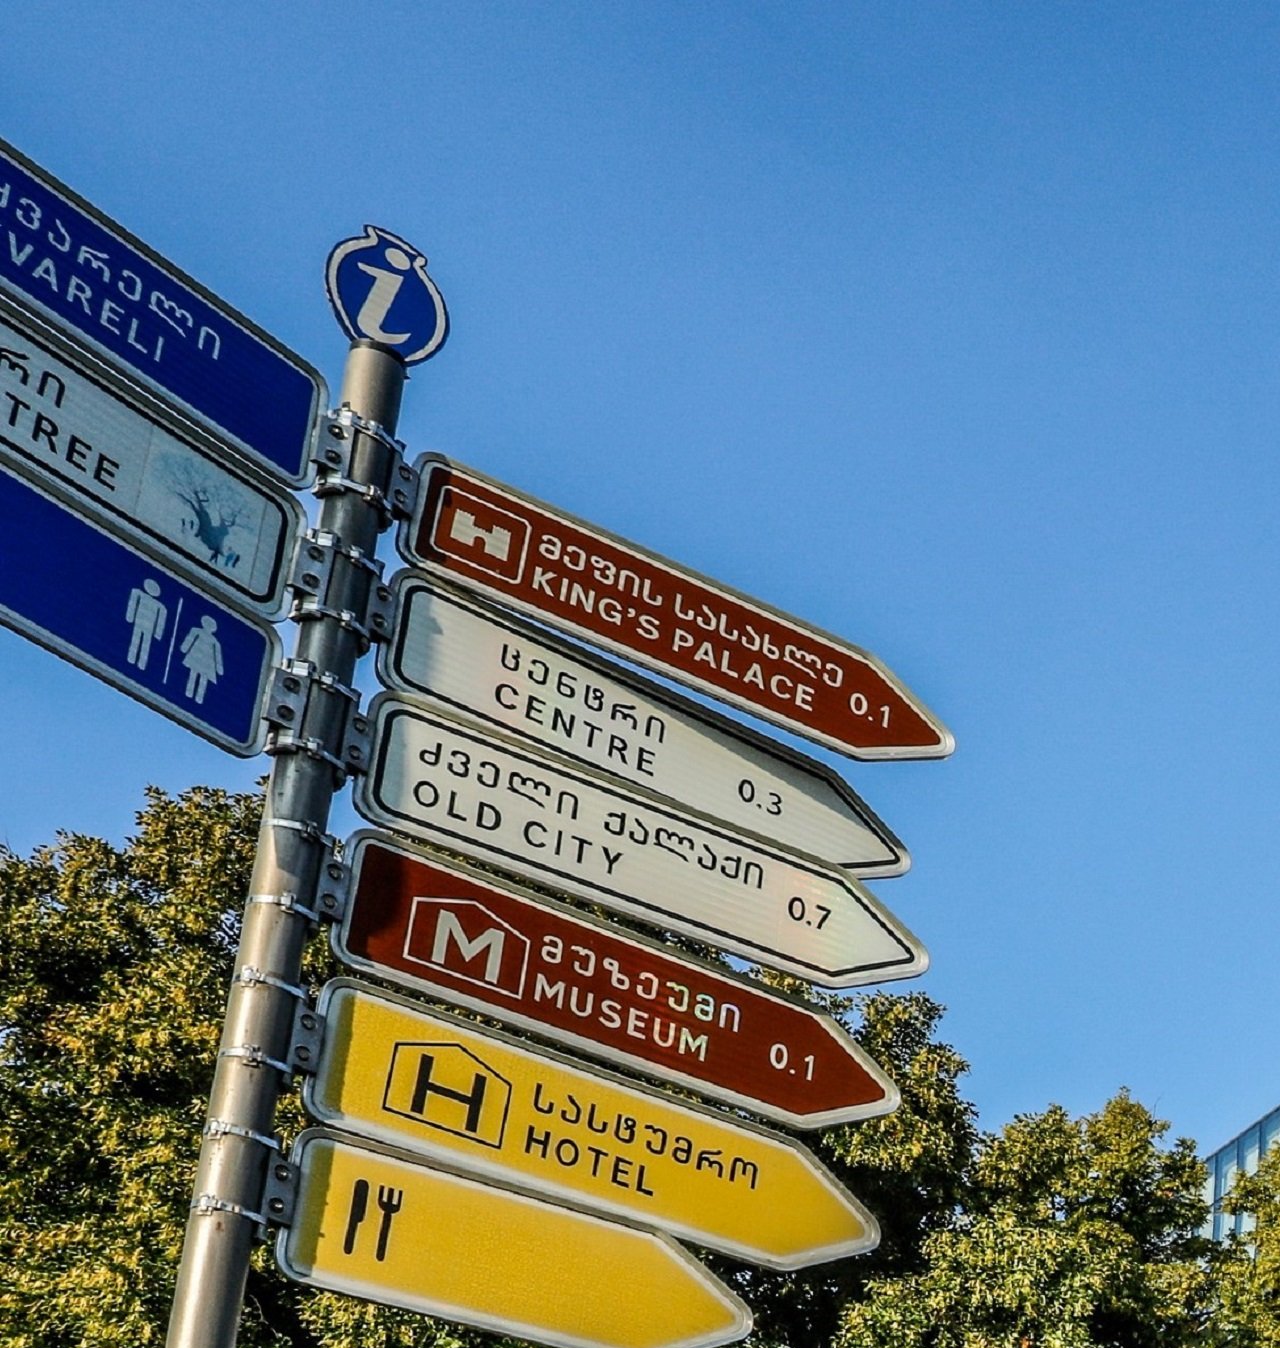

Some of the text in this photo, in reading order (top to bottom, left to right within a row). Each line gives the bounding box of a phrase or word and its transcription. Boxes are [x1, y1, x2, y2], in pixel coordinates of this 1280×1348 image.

[0, 226, 164, 362] VARELI
[5, 391, 120, 492] TREE
[532, 566, 815, 711] KING'S PALACE
[538, 534, 843, 688] მეფის სასახლე
[495, 683, 656, 776] CENTRE
[501, 644, 666, 743] ცენტრი
[849, 692, 890, 728] 0.1
[413, 780, 624, 875] OLD CITY
[419, 743, 764, 889] ძველი ქალაქი
[738, 779, 782, 815] 0.3
[788, 897, 831, 930] 0.7
[534, 973, 709, 1062] MUSEUM
[541, 935, 742, 1032] მუზეუმი
[769, 1044, 815, 1081] 0.1
[524, 1125, 653, 1196] HOTEL
[533, 1083, 759, 1190] სასტუმრო
